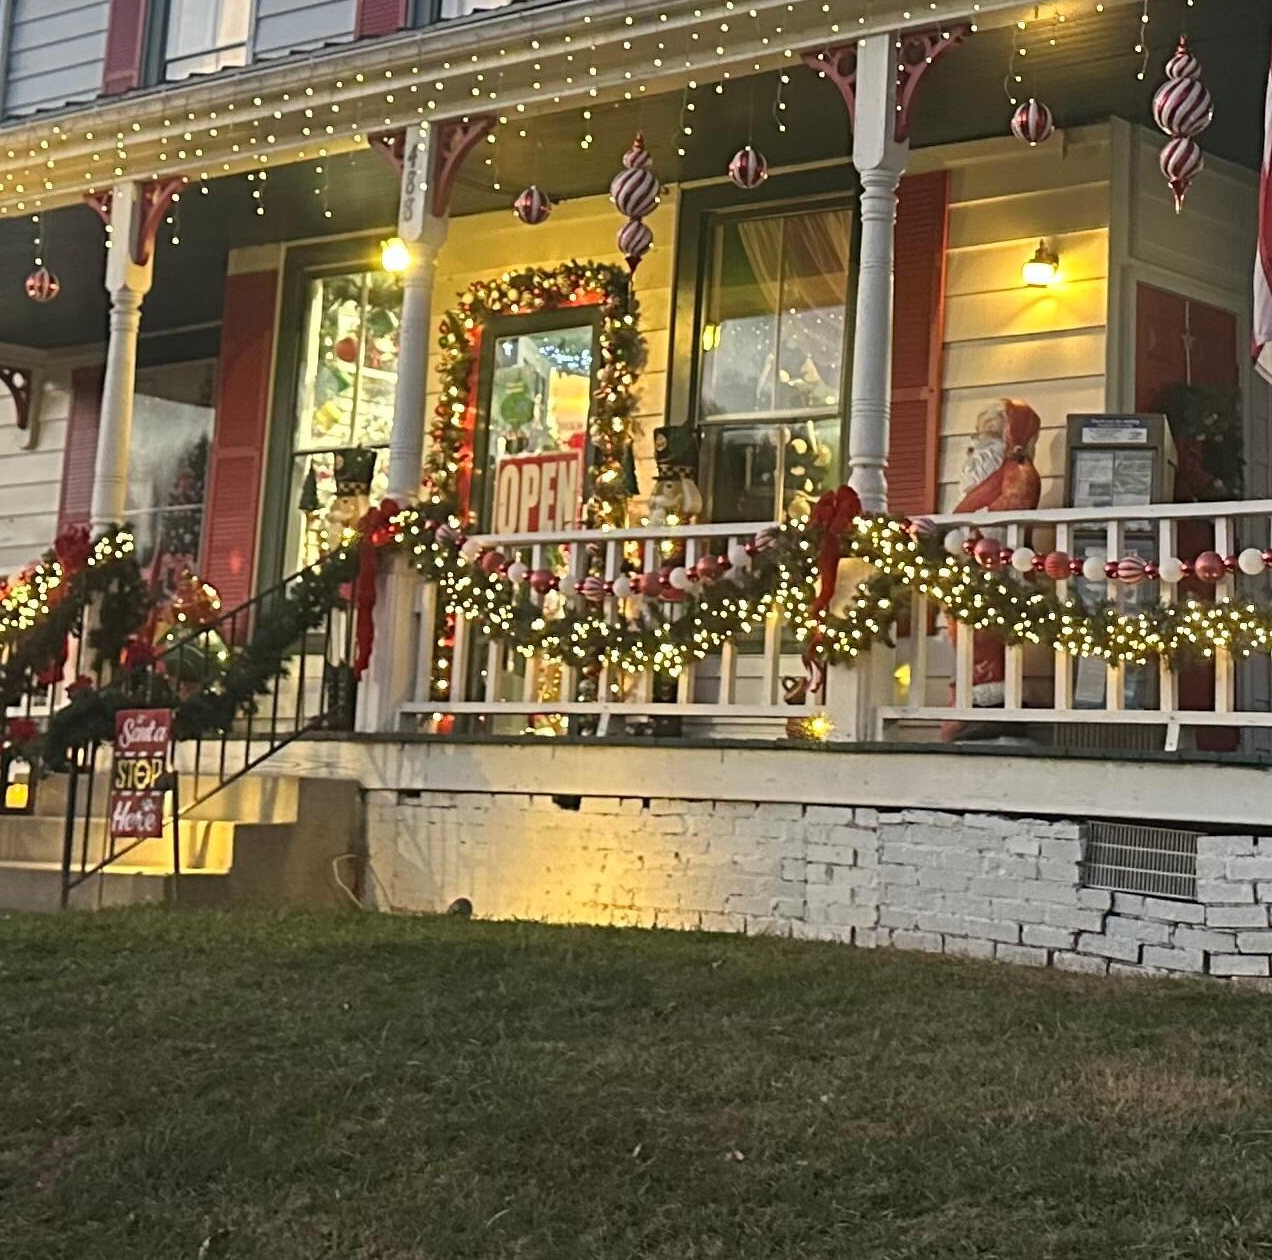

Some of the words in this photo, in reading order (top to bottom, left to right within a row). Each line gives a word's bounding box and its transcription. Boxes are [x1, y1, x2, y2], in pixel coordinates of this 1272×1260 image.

[496, 459, 578, 535] OPEN
[118, 717, 168, 749] Santa
[115, 759, 163, 790] STOP
